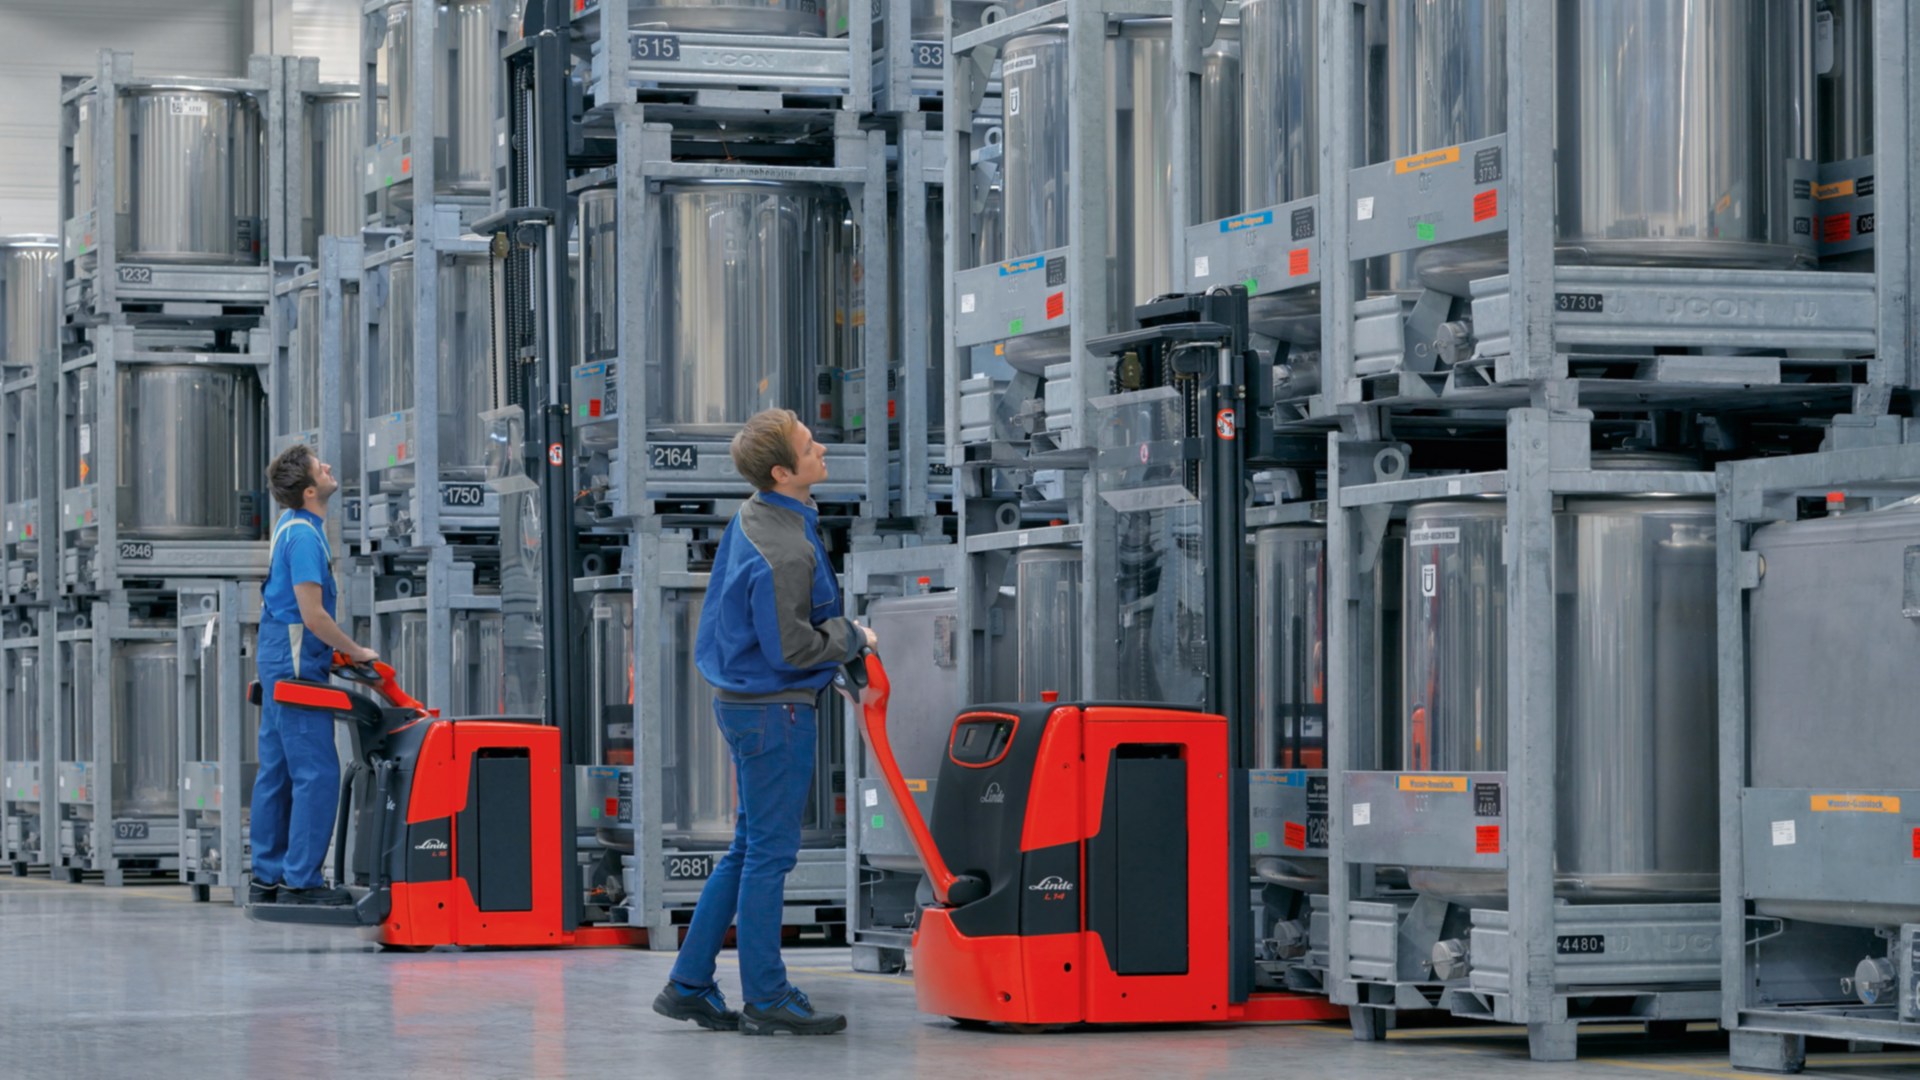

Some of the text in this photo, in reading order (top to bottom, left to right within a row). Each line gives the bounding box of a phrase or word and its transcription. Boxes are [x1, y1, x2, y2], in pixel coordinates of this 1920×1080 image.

[637, 38, 674, 57] 515
[701, 51, 776, 68] UCON
[1479, 166, 1498, 182] 3730
[120, 269, 150, 282] 1232
[1560, 296, 1596, 310] 3730
[1658, 296, 1765, 319] UCON
[654, 448, 692, 466] 2164
[447, 487, 480, 504] 1750
[122, 544, 152, 558] 2846
[980, 782, 1005, 803] Linde
[1479, 802, 1497, 815] 4480
[120, 824, 145, 837] 972
[414, 838, 448, 850] Linde
[670, 858, 708, 877] 2681
[1028, 875, 1074, 891] Linde
[1044, 892, 1065, 900] L 14
[1562, 937, 1598, 951] 4480
[1660, 934, 1721, 952] UC
